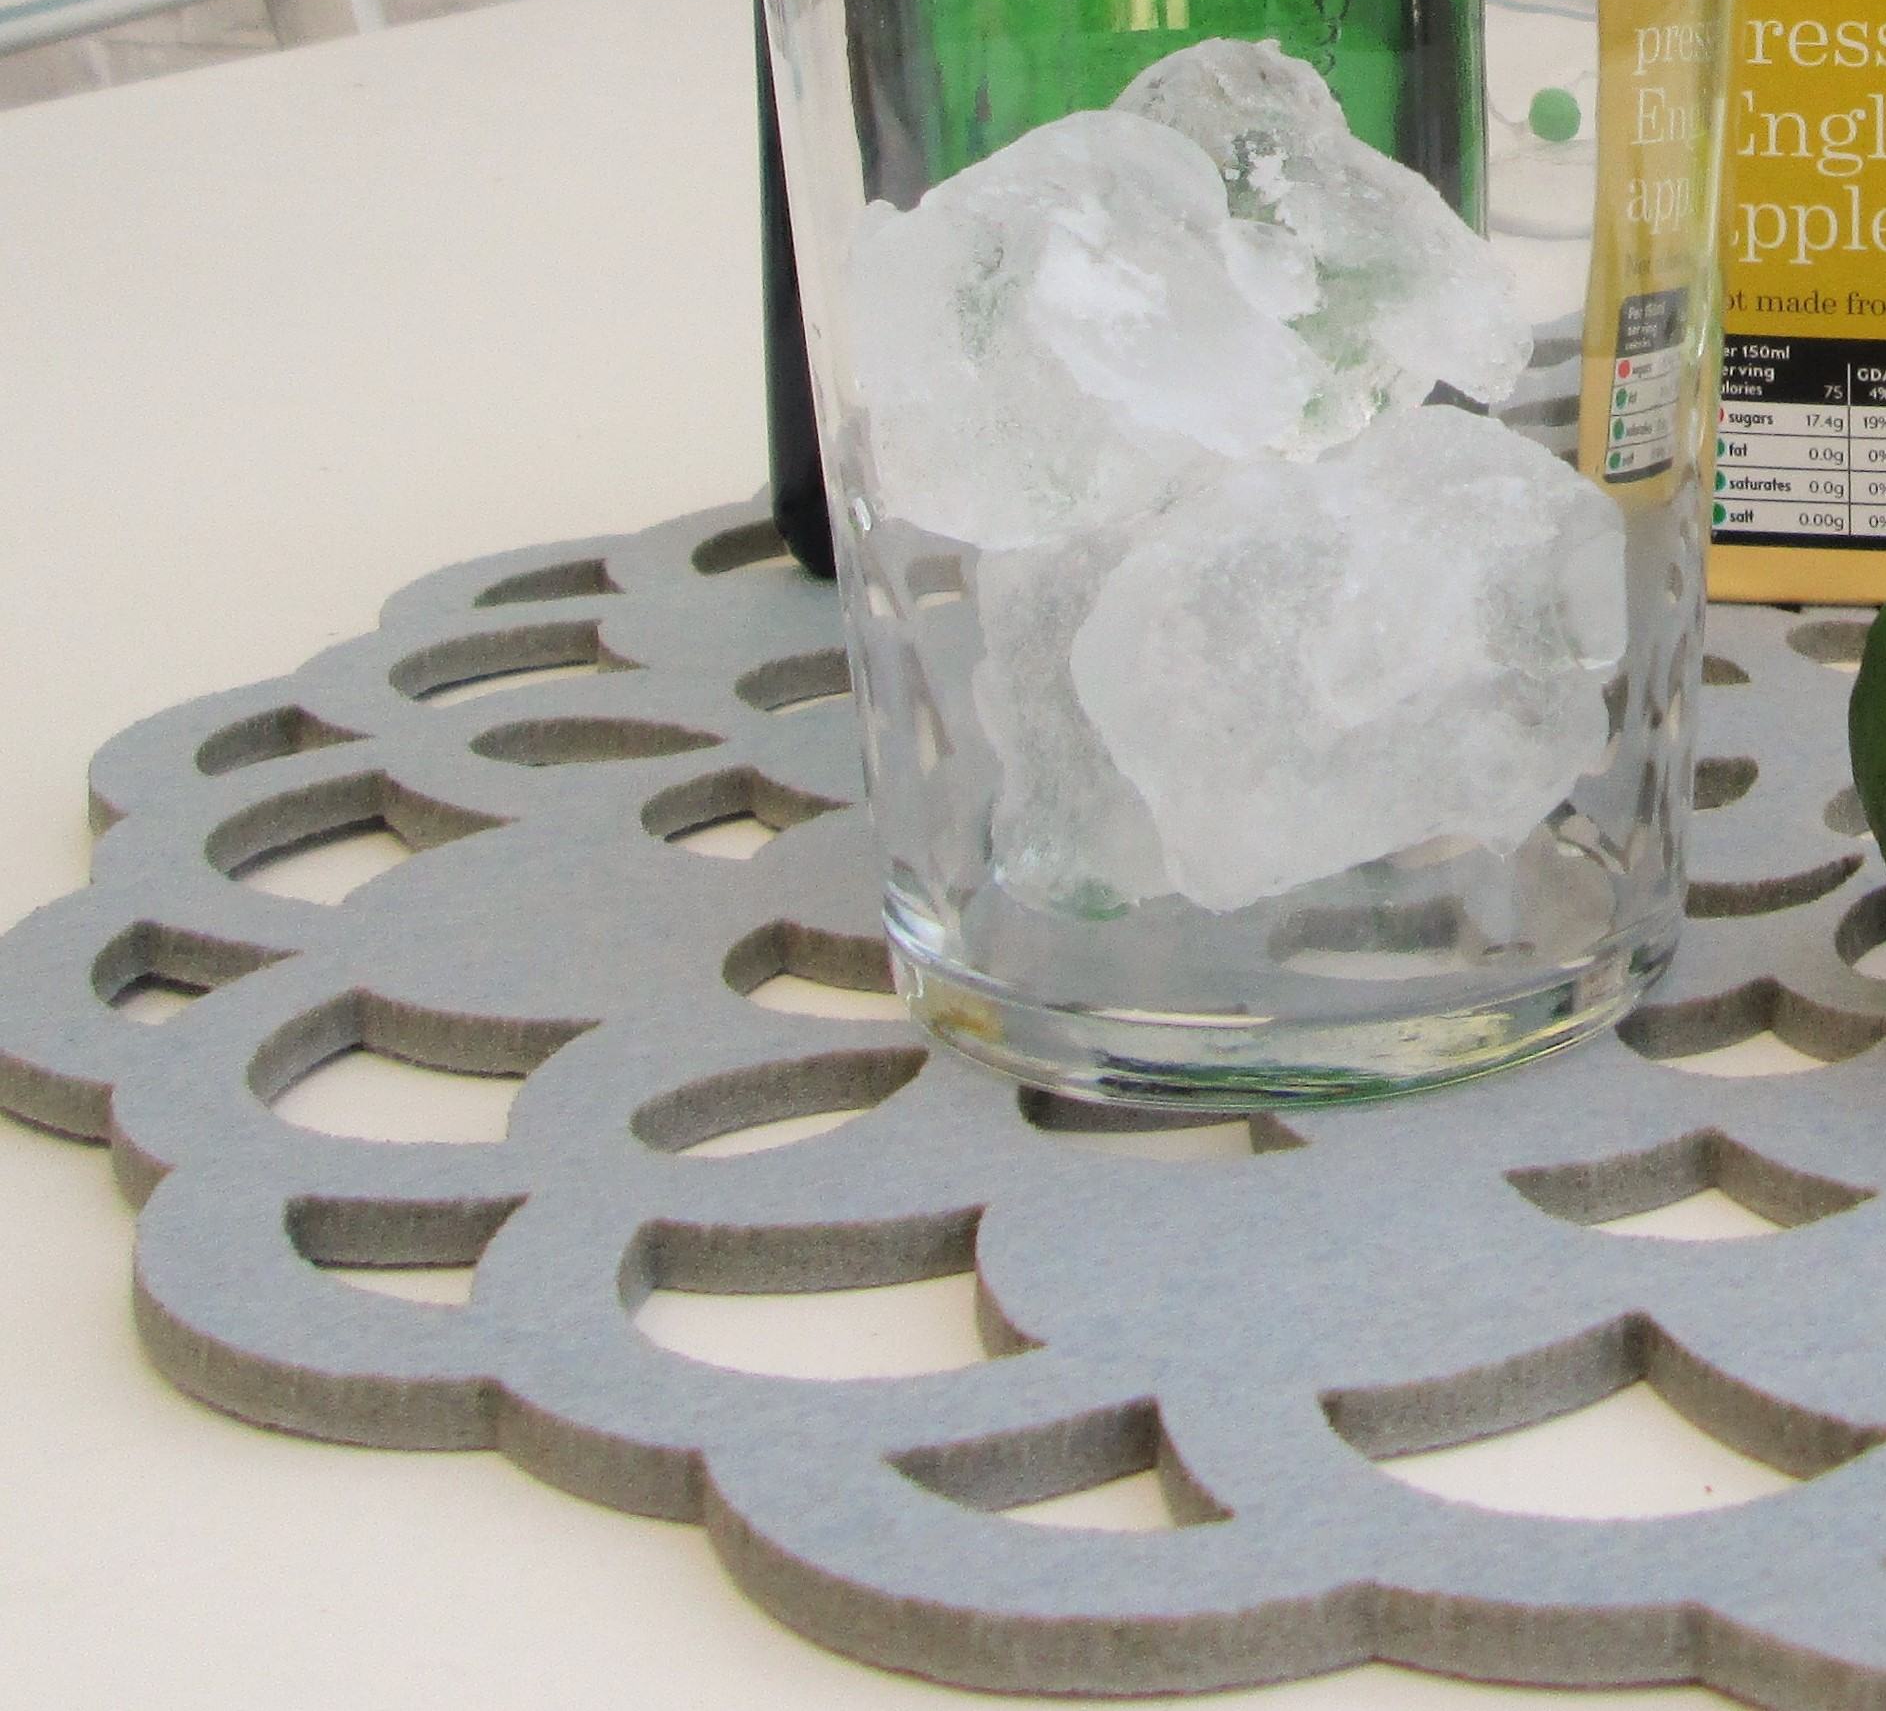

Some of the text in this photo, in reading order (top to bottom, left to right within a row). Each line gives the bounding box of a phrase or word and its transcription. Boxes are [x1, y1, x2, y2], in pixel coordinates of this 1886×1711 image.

[1755, 290, 1837, 315] made
[1724, 345, 1791, 360] er 150ml
[1722, 363, 1776, 382] erving
[1823, 384, 1844, 400] 75
[1728, 413, 1774, 428] sugars
[1806, 414, 1845, 432] 17.4g
[1728, 443, 1748, 457] fat
[1808, 447, 1845, 465] 0.0g
[1728, 476, 1792, 492] saturates
[1808, 480, 1845, 499] 0.0g
[1729, 509, 1755, 524] salt
[1798, 512, 1845, 532] 0.00g
